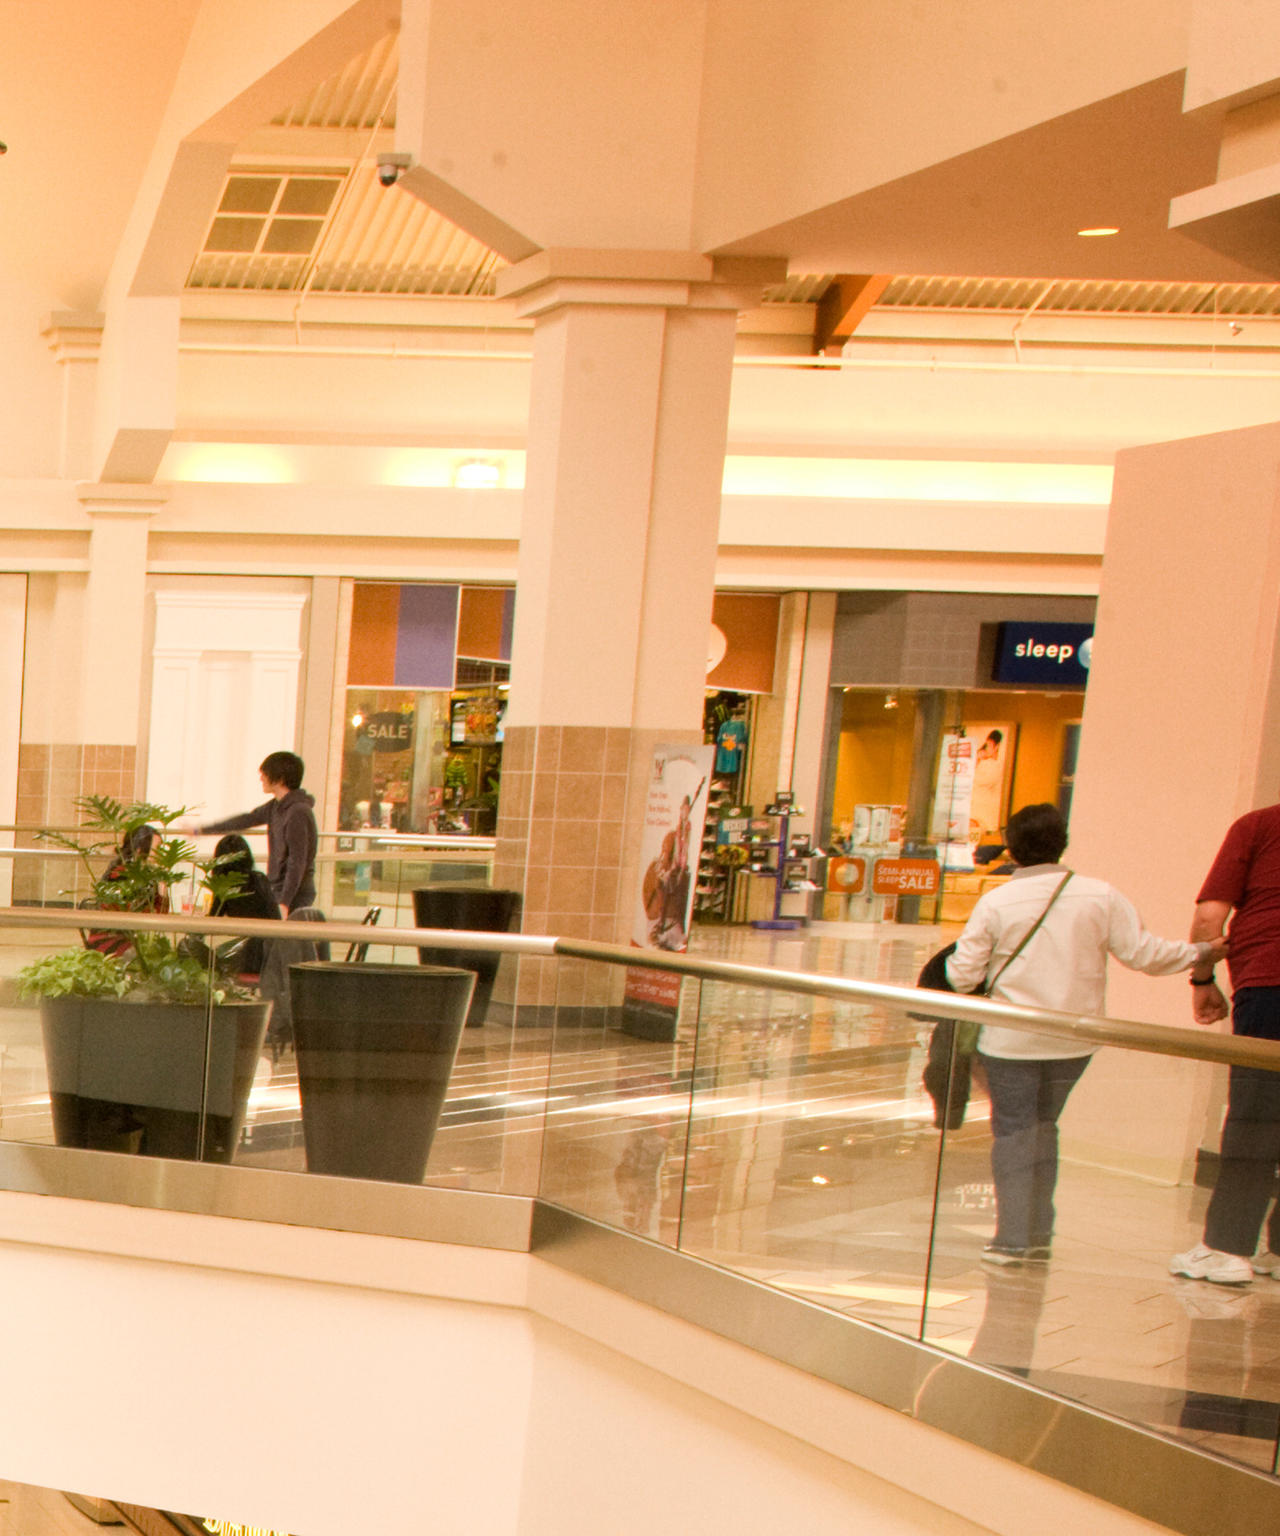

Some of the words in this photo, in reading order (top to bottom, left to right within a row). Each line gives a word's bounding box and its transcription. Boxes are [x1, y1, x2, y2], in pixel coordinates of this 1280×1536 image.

[1015, 638, 1074, 664] sleep
[367, 724, 409, 740] SALE
[898, 876, 934, 890] SALE
